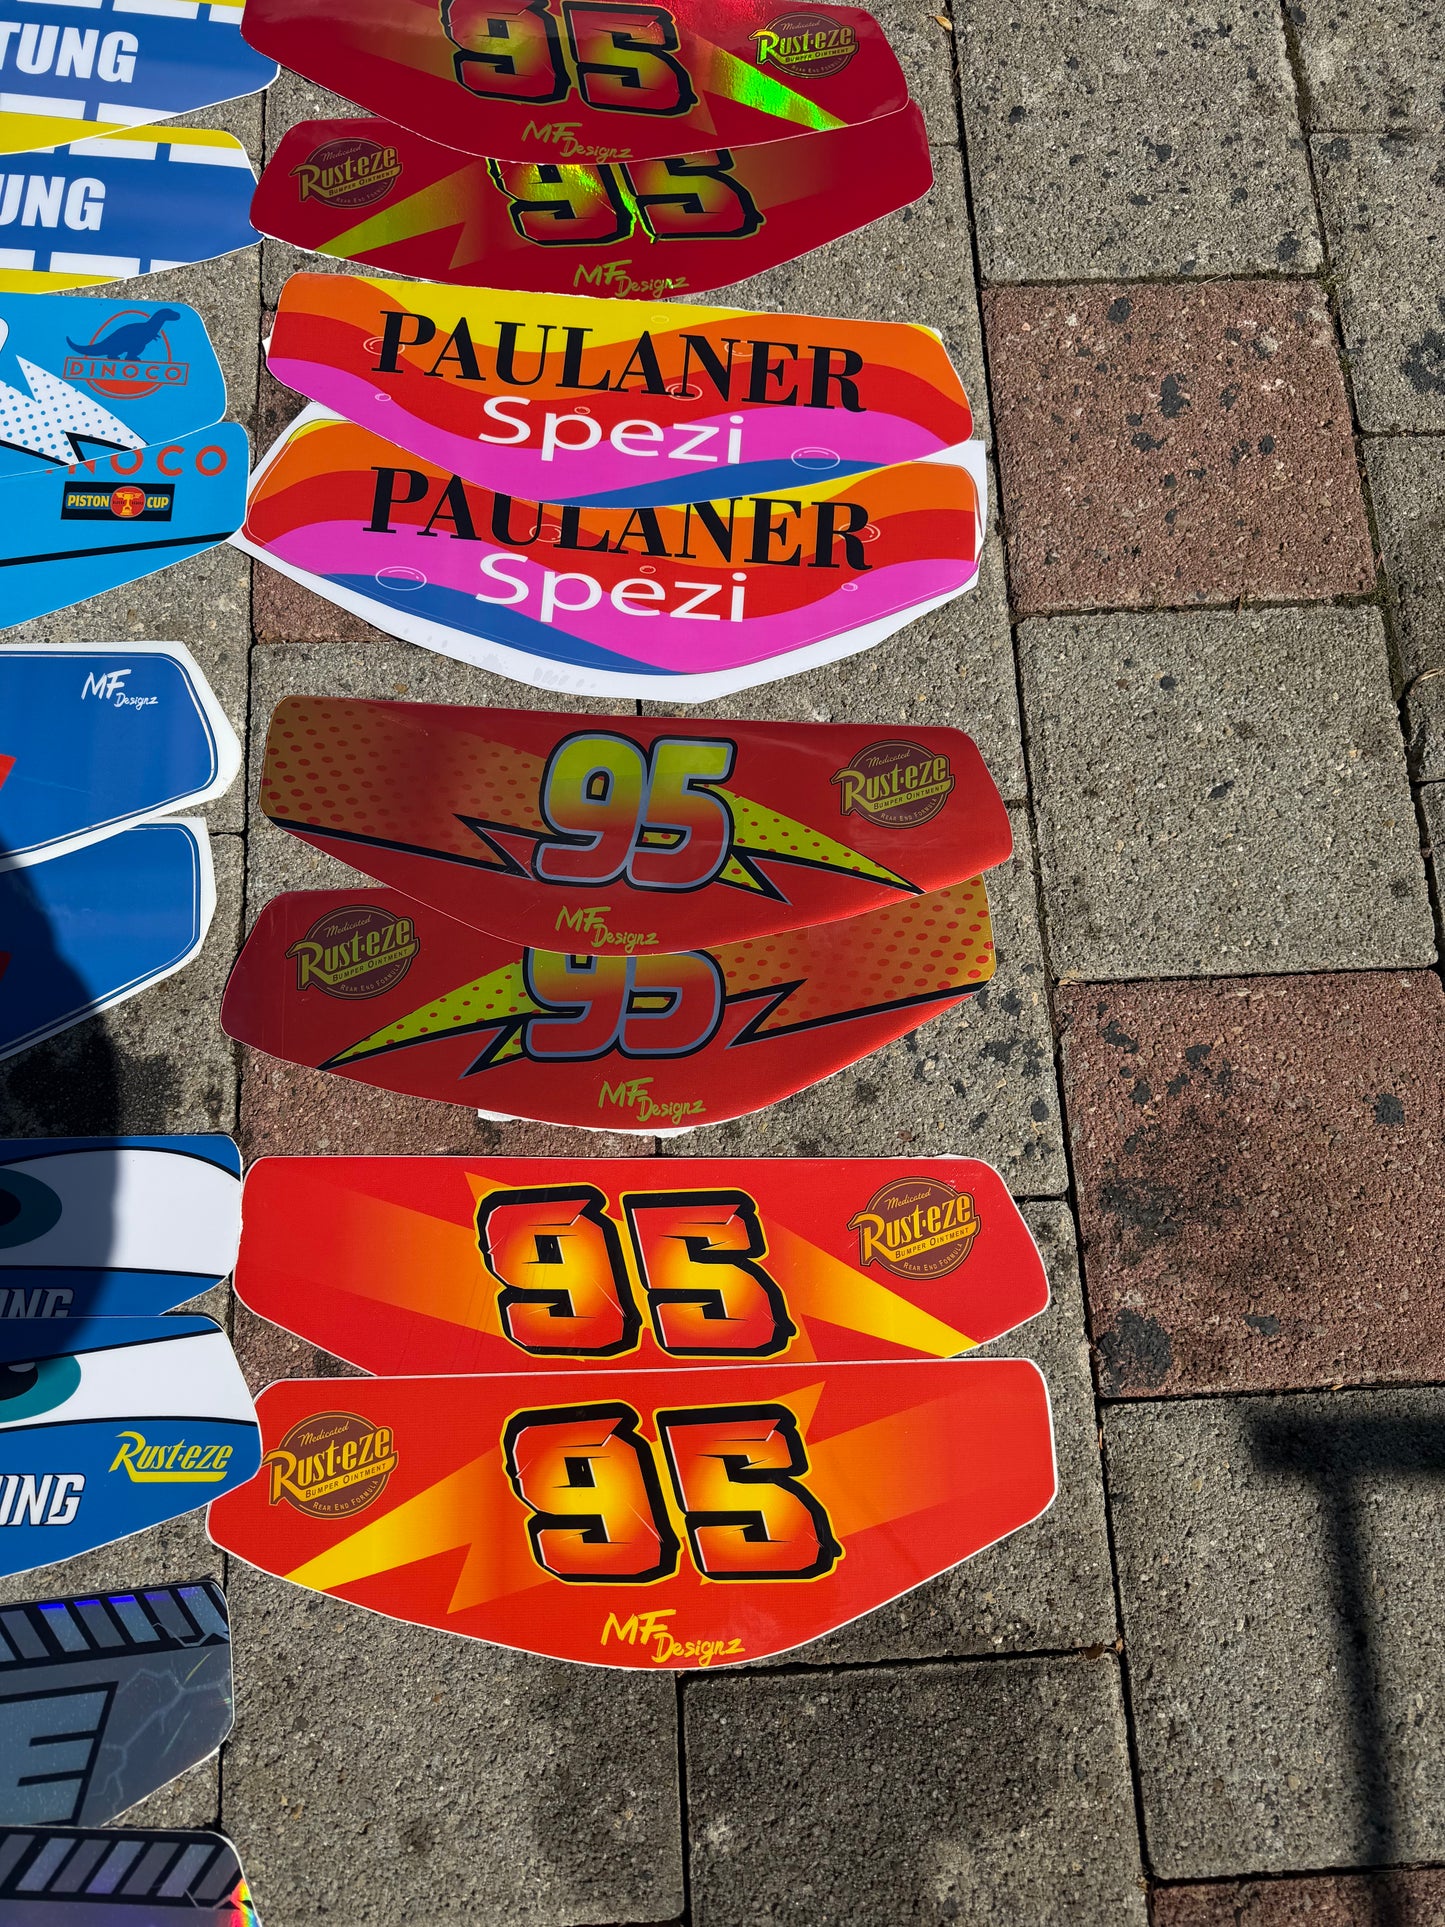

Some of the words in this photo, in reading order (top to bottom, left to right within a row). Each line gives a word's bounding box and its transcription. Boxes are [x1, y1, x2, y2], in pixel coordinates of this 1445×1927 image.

[781, 20, 820, 31] Medicated
[439, 0, 700, 117] 95
[321, 143, 362, 161] Medicated
[521, 120, 583, 143] MF
[560, 137, 633, 163] Designz
[486, 148, 766, 247] 95
[573, 259, 632, 287] MF
[615, 275, 689, 298] Designz
[69, 361, 182, 381] DINOCO
[371, 310, 867, 413] PAULANER
[478, 395, 744, 464] Spezi
[67, 494, 110, 508] PISTON
[146, 496, 170, 509] CUP
[362, 466, 872, 571] PAULANER
[475, 553, 747, 624] Spezi
[81, 668, 131, 700] MF
[114, 692, 159, 710] Designz
[865, 749, 911, 768] Medicated
[529, 730, 739, 892] 95
[873, 797, 903, 810] BUMPER
[906, 784, 944, 800] OINTMENT
[323, 914, 372, 938] Medicated
[555, 905, 611, 931] MF
[591, 923, 659, 954] Designz
[332, 965, 364, 982] BUMPER
[367, 948, 408, 968] OINTMENT
[340, 984, 358, 992] REAR
[361, 983, 375, 992] END
[376, 963, 401, 987] FORMULA
[598, 1077, 654, 1108] MF
[636, 1096, 707, 1125] Designz
[884, 1187, 932, 1211] Medicated
[895, 1243, 927, 1259] BUMPER
[929, 1226, 970, 1246] OINTMENT
[903, 1261, 921, 1271] REAR
[923, 1263, 938, 1271] END
[939, 1242, 963, 1266] FORMULA
[473, 1182, 799, 1361] 95
[0, 1288, 74, 1318] NG
[297, 1421, 350, 1447] Medicated
[305, 1480, 339, 1498] BUMPER
[342, 1463, 387, 1484] OINTMENT
[312, 1501, 332, 1511] REAR
[334, 1502, 349, 1511] END
[351, 1479, 379, 1505] FORMULA
[500, 1398, 846, 1585] 95
[0, 1473, 86, 1527] ING
[600, 1609, 677, 1646] MF
[651, 1632, 746, 1667] Designz
